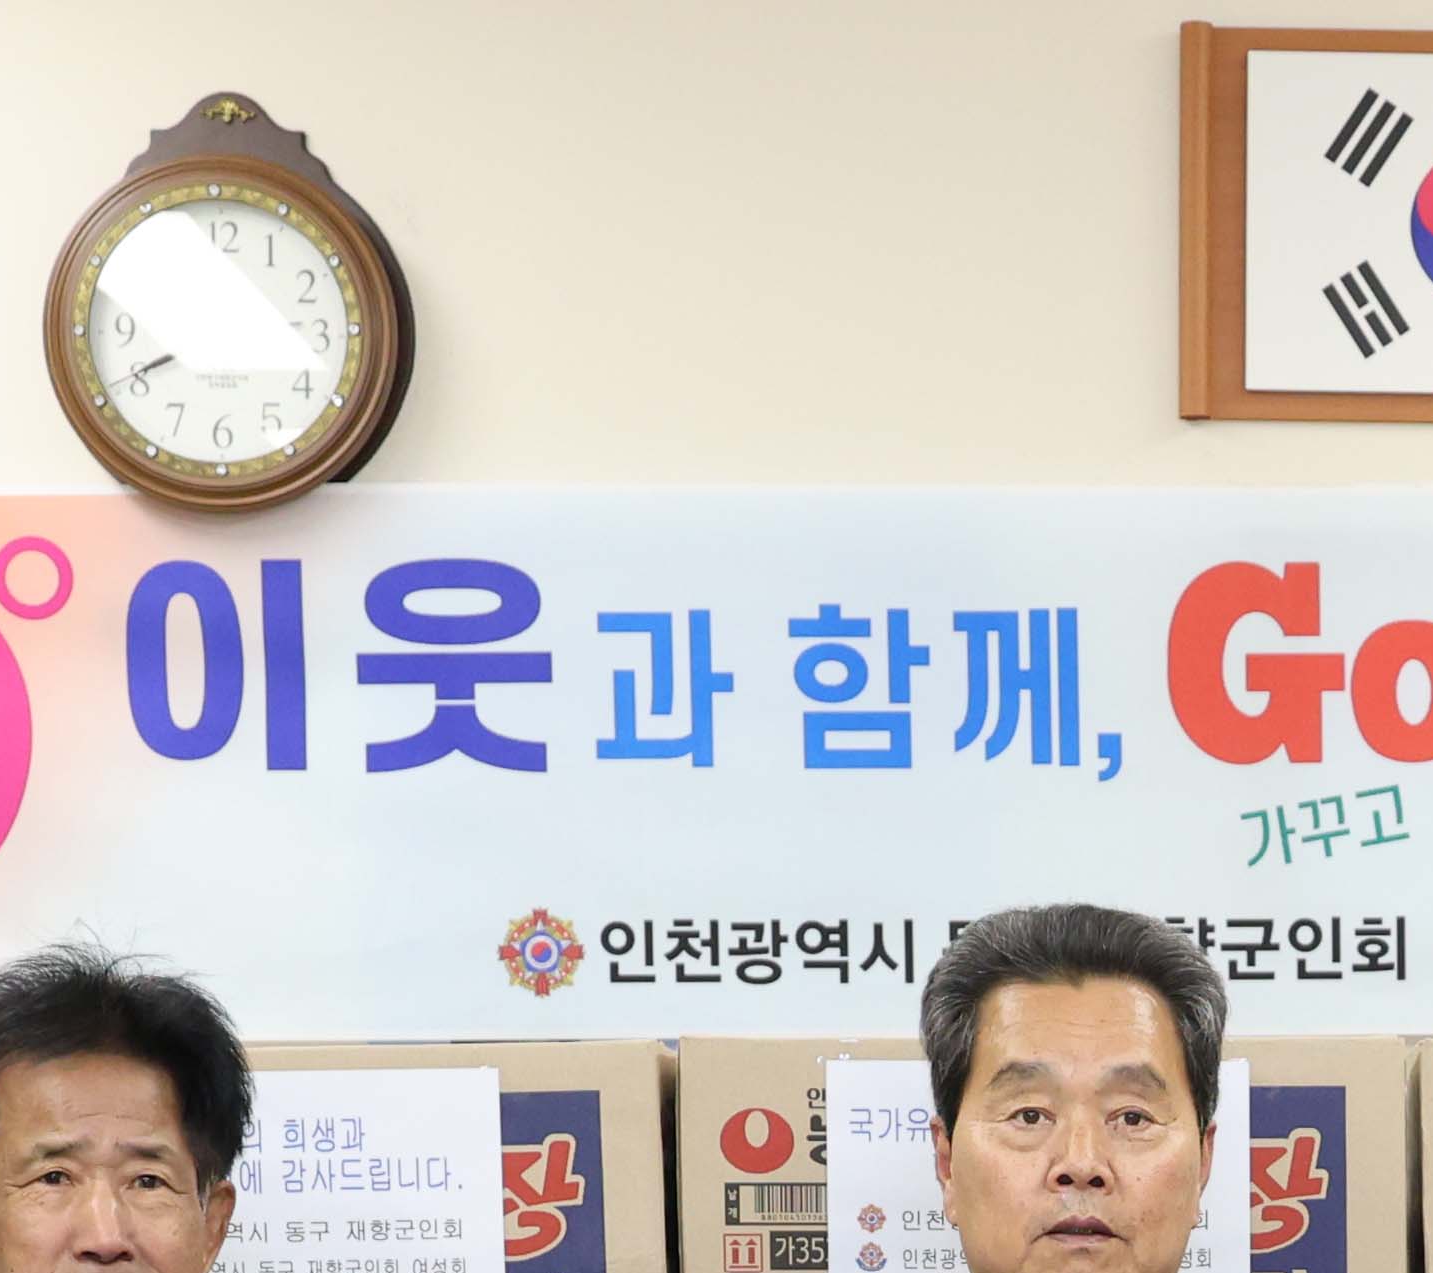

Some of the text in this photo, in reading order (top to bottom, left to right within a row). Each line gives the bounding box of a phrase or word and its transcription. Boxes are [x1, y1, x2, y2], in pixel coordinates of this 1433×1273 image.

[264, 234, 275, 267] 1
[297, 270, 317, 304] 2
[115, 313, 134, 346] 9
[312, 319, 330, 354] 3
[129, 364, 149, 396] 8
[292, 368, 314, 399] 4
[166, 403, 185, 437] 7
[212, 415, 232, 448] 6
[261, 403, 281, 431] 5
[788, 604, 1122, 782] 함께,
[1240, 784, 1410, 867] 가꾸고
[601, 919, 914, 984] 인천광역시
[283, 1117, 365, 1152] 희생과
[282, 1158, 462, 1193] 감사드립니다.
[285, 1221, 329, 1243] 동구
[347, 1219, 462, 1241] 재향군인회
[775, 1236, 828, 1266] 가35
